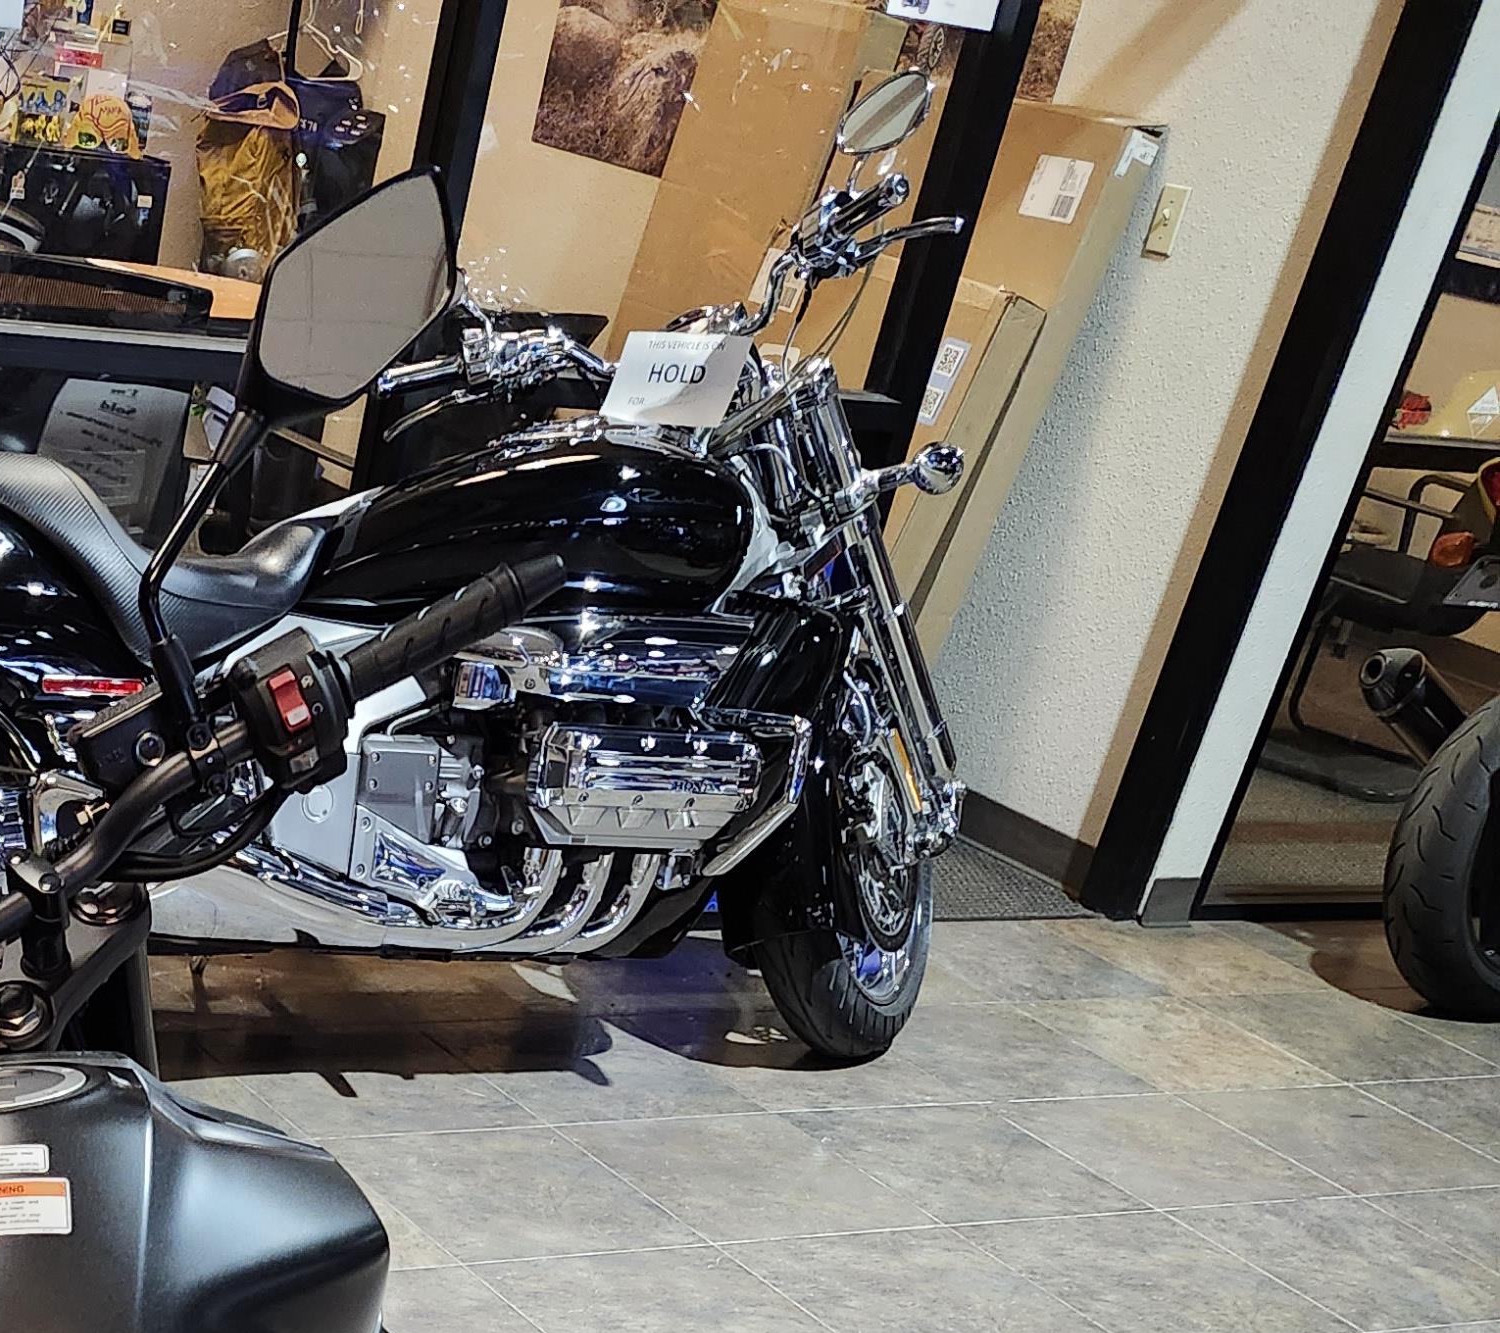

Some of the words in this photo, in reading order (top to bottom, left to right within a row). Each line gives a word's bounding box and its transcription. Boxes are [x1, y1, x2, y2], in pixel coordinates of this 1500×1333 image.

[648, 340, 667, 350] THIS
[667, 341, 700, 350] VEHICLE
[701, 341, 710, 350] IS
[710, 341, 726, 351] ON
[647, 362, 707, 385] HOLD
